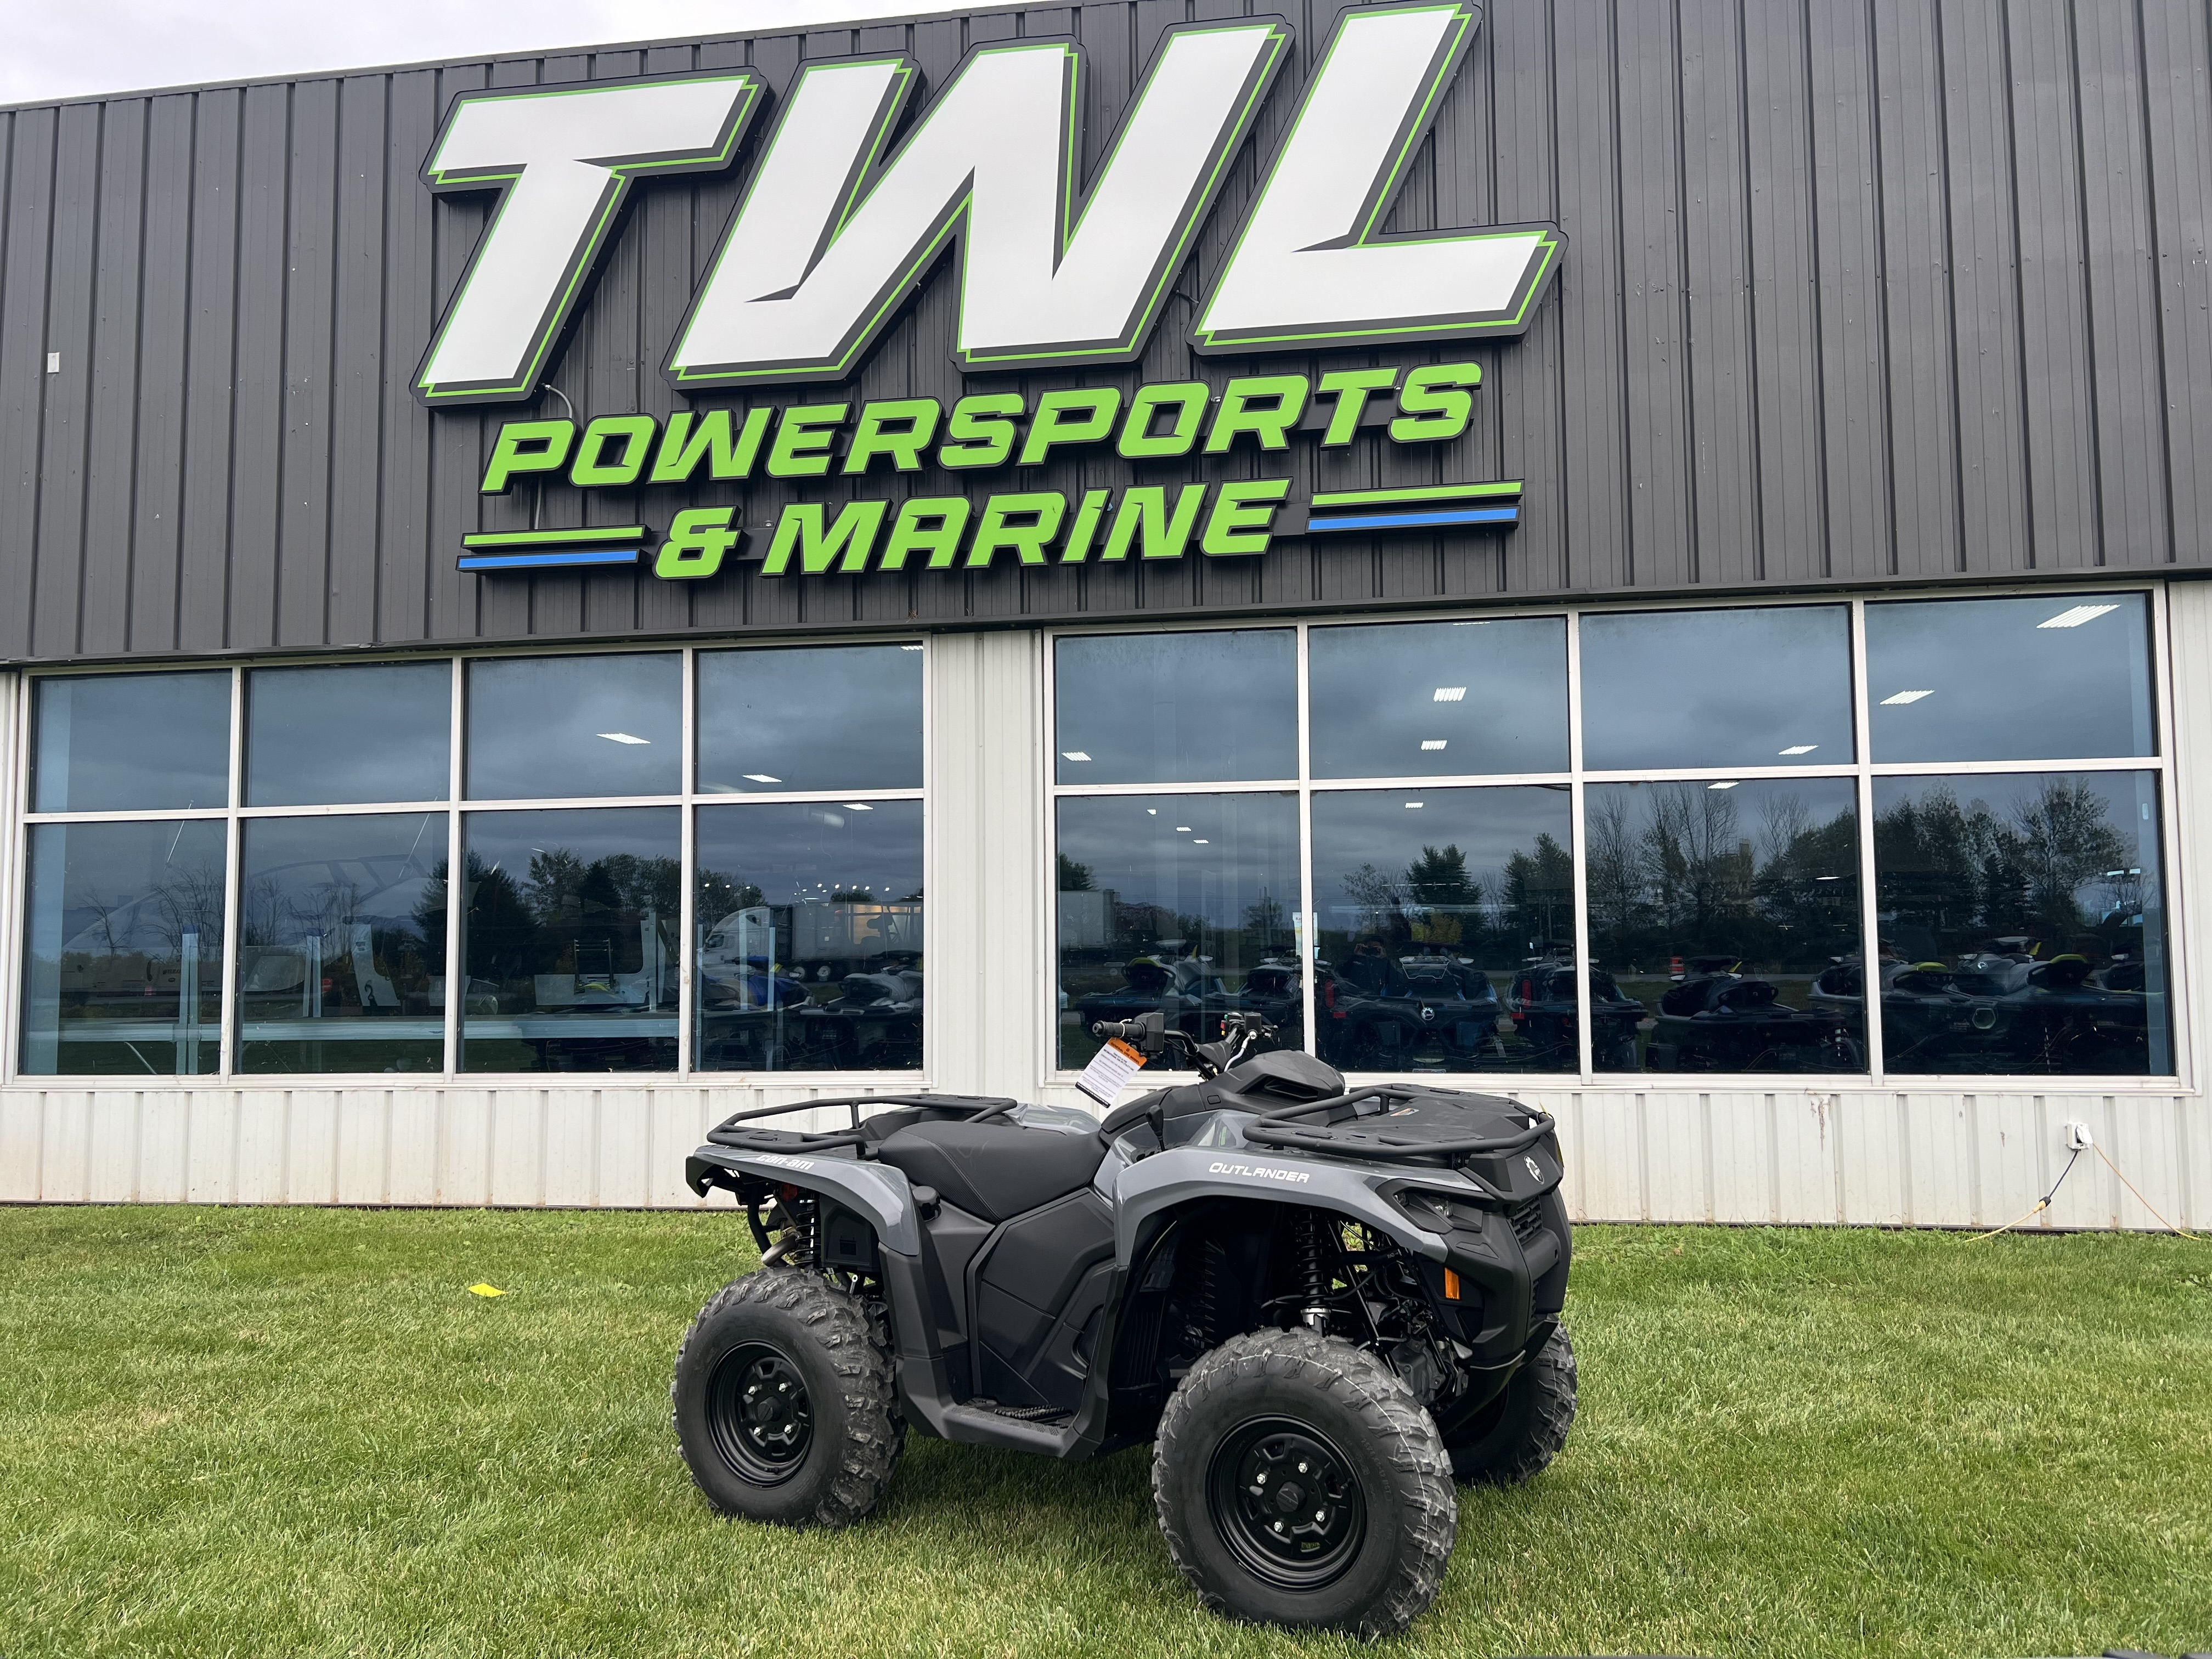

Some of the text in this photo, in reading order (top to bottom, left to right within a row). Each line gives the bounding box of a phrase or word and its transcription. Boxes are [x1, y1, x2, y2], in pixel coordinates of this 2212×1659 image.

[416, 3, 1561, 399] TWL
[484, 363, 1483, 489] POWERSPORTS
[656, 479, 1290, 578] & MARINE
[1110, 1042, 1124, 1052] GENERAL
[1130, 1055, 1139, 1064] MODEL
[756, 1154, 815, 1170] can-am
[1209, 1162, 1310, 1183] OUTLANDER
